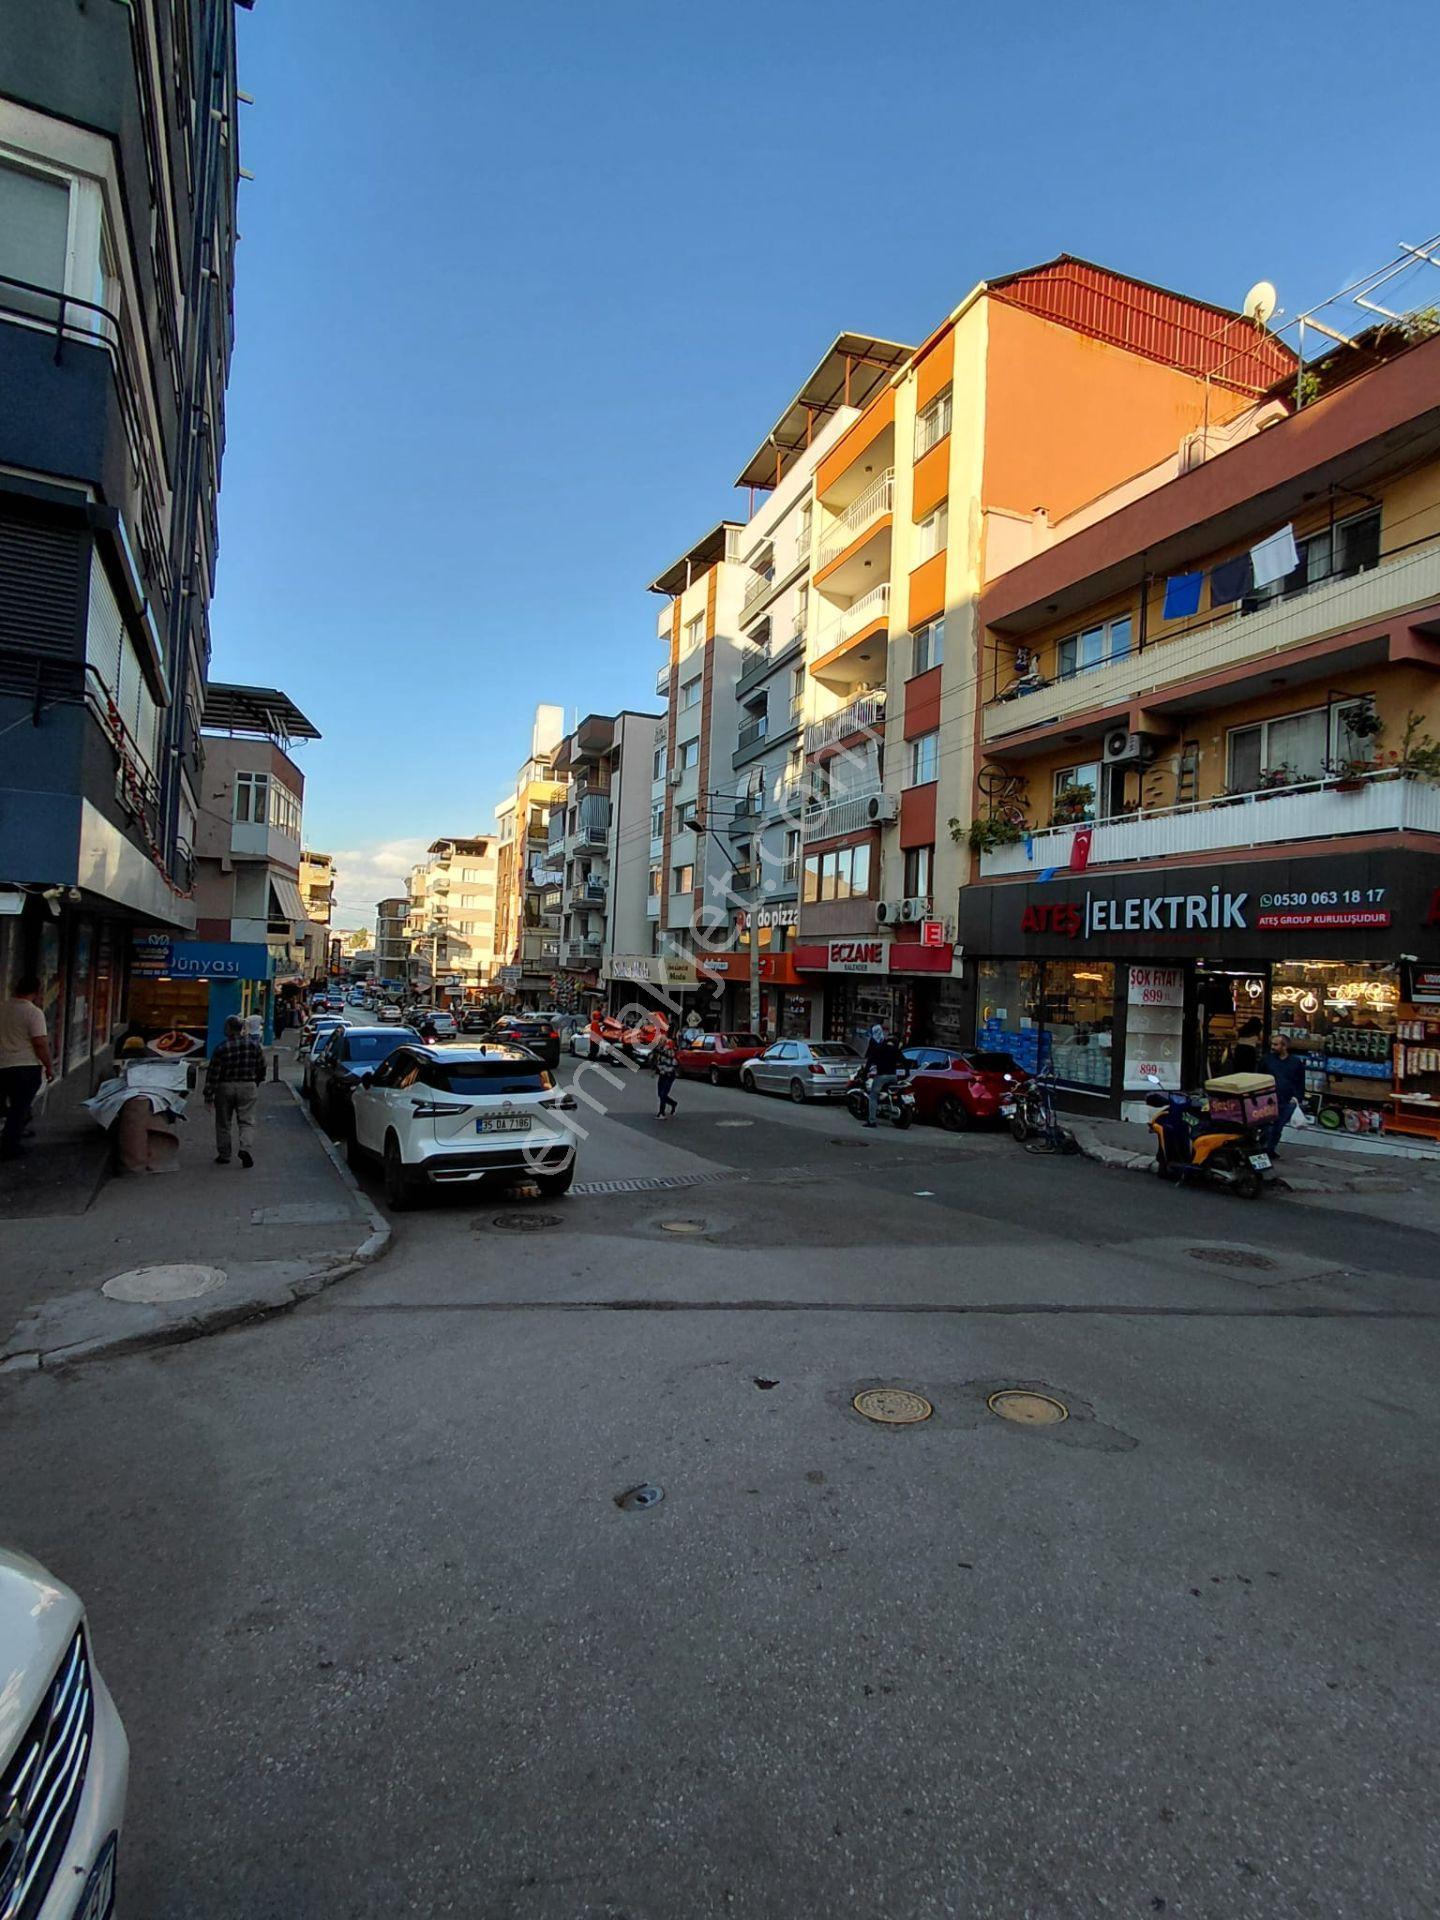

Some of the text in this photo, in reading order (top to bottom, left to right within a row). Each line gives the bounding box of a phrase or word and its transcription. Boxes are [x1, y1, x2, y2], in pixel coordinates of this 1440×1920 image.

[1274, 888, 1386, 906] 0530 063 18 17
[1021, 885, 1249, 940] ATEŞ ELEKTRİK
[1259, 913, 1386, 926] ATEŞ GROUP KURULUŞUDUR
[924, 926, 941, 943] E
[830, 943, 883, 963] ECZANE
[1130, 969, 1151, 989] ŞOK
[1153, 969, 1179, 988] FİYAT
[1142, 988, 1163, 1003] 899
[1139, 1062, 1158, 1075] 899
[482, 1120, 493, 1130] 35
